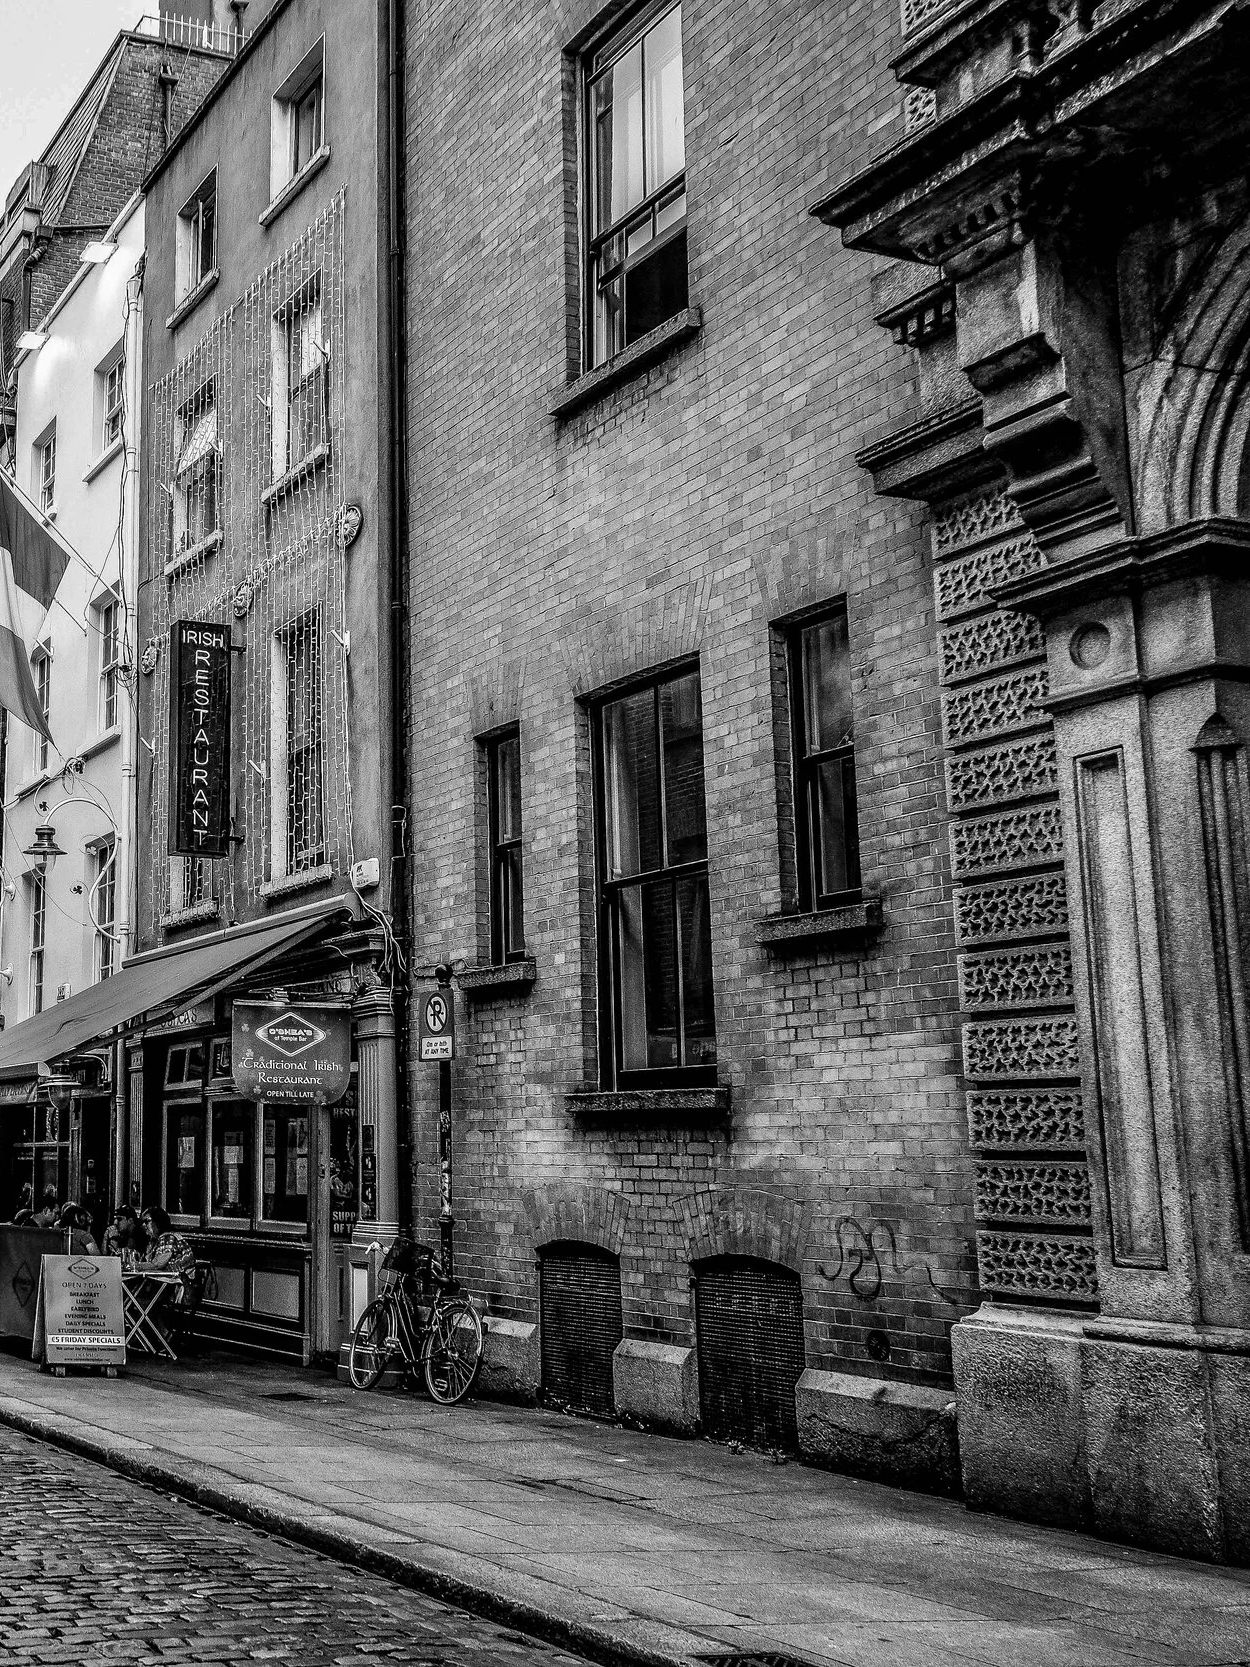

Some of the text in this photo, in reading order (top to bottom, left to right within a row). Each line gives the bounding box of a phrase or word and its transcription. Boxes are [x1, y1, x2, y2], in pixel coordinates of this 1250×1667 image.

[182, 629, 225, 648] IRISH
[192, 649, 211, 846] RESTAURANT
[268, 1028, 313, 1036] O'SHEA'S
[241, 1057, 340, 1071] Traditional Irish
[258, 1072, 323, 1085] Restaurant
[266, 1090, 285, 1098] OPEN
[286, 1090, 298, 1098] TILL
[333, 1223, 345, 1234] OF
[88, 1336, 121, 1344] SPECIALS
